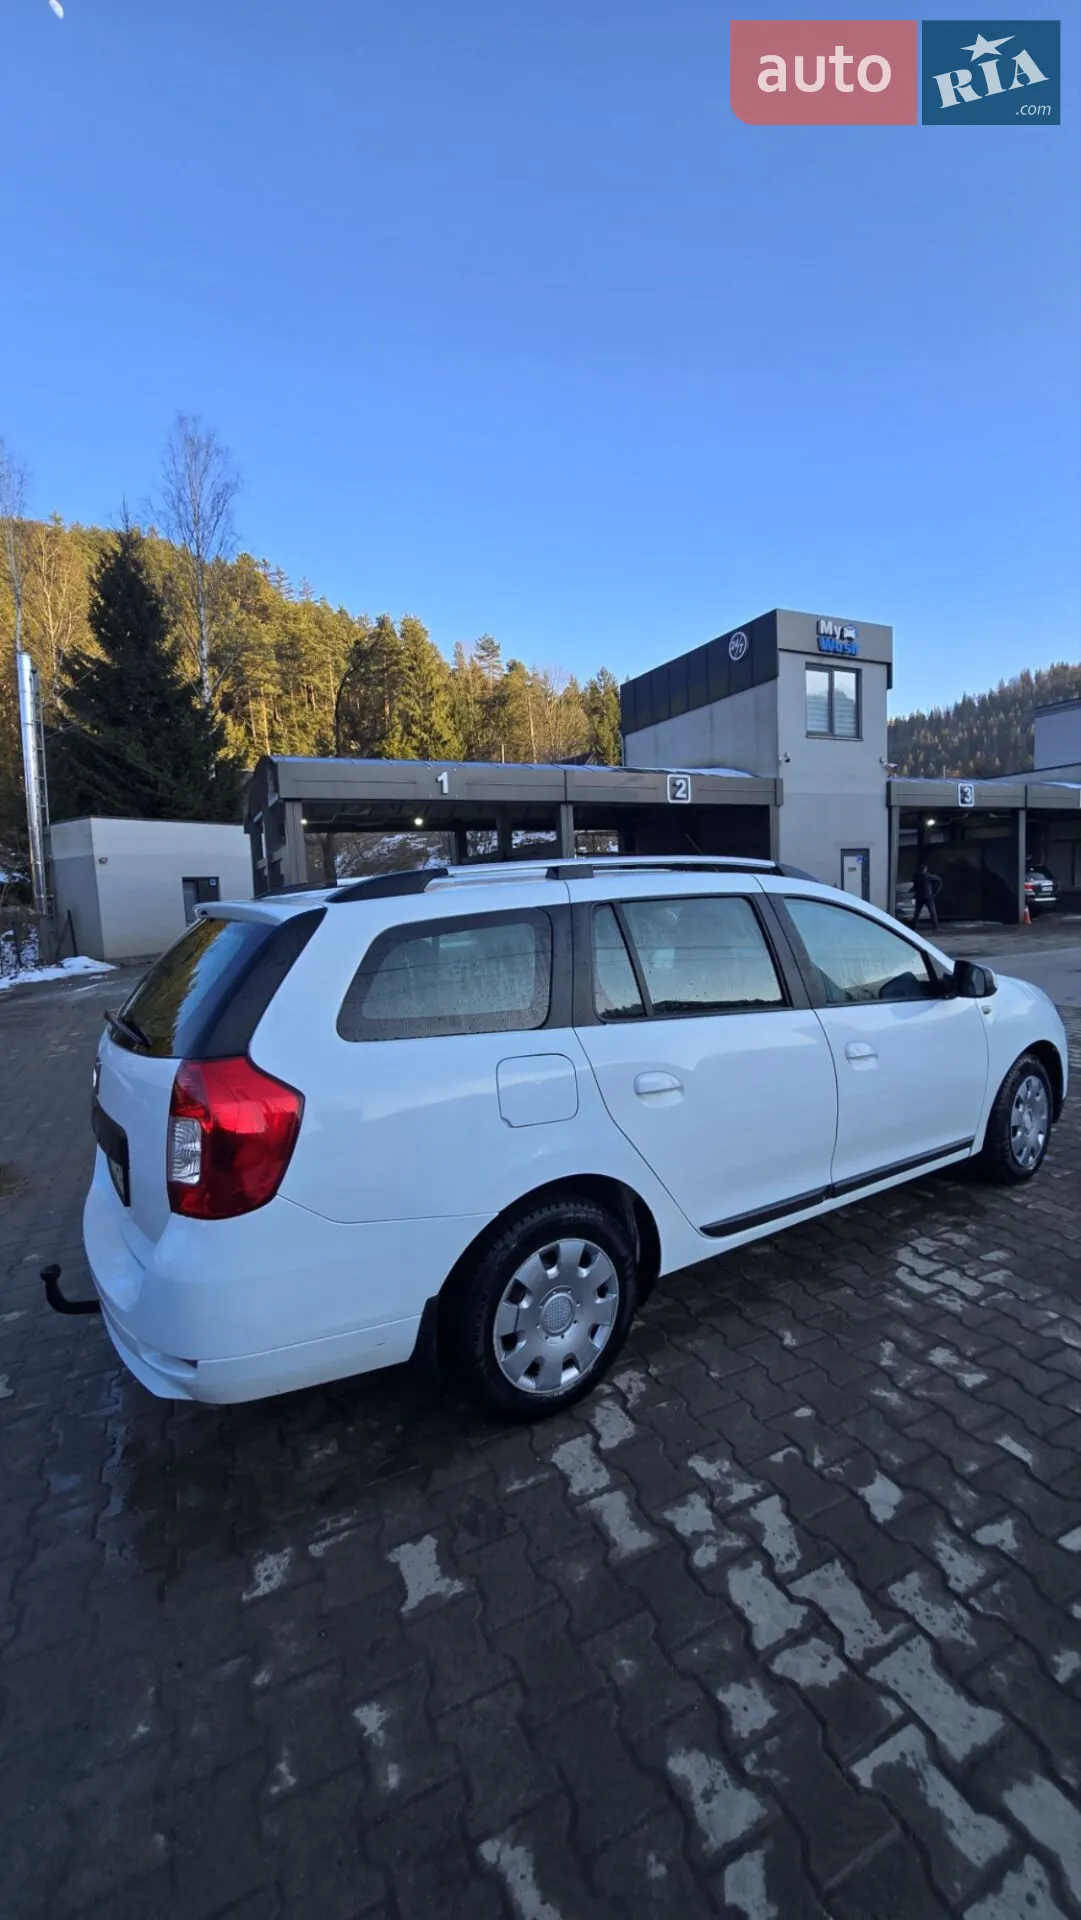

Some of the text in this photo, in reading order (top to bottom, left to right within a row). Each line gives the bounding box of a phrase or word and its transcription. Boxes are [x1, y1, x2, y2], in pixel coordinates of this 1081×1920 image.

[820, 619, 842, 640] My
[437, 771, 449, 794] 1
[675, 778, 687, 799] 2
[964, 786, 972, 802] 3
